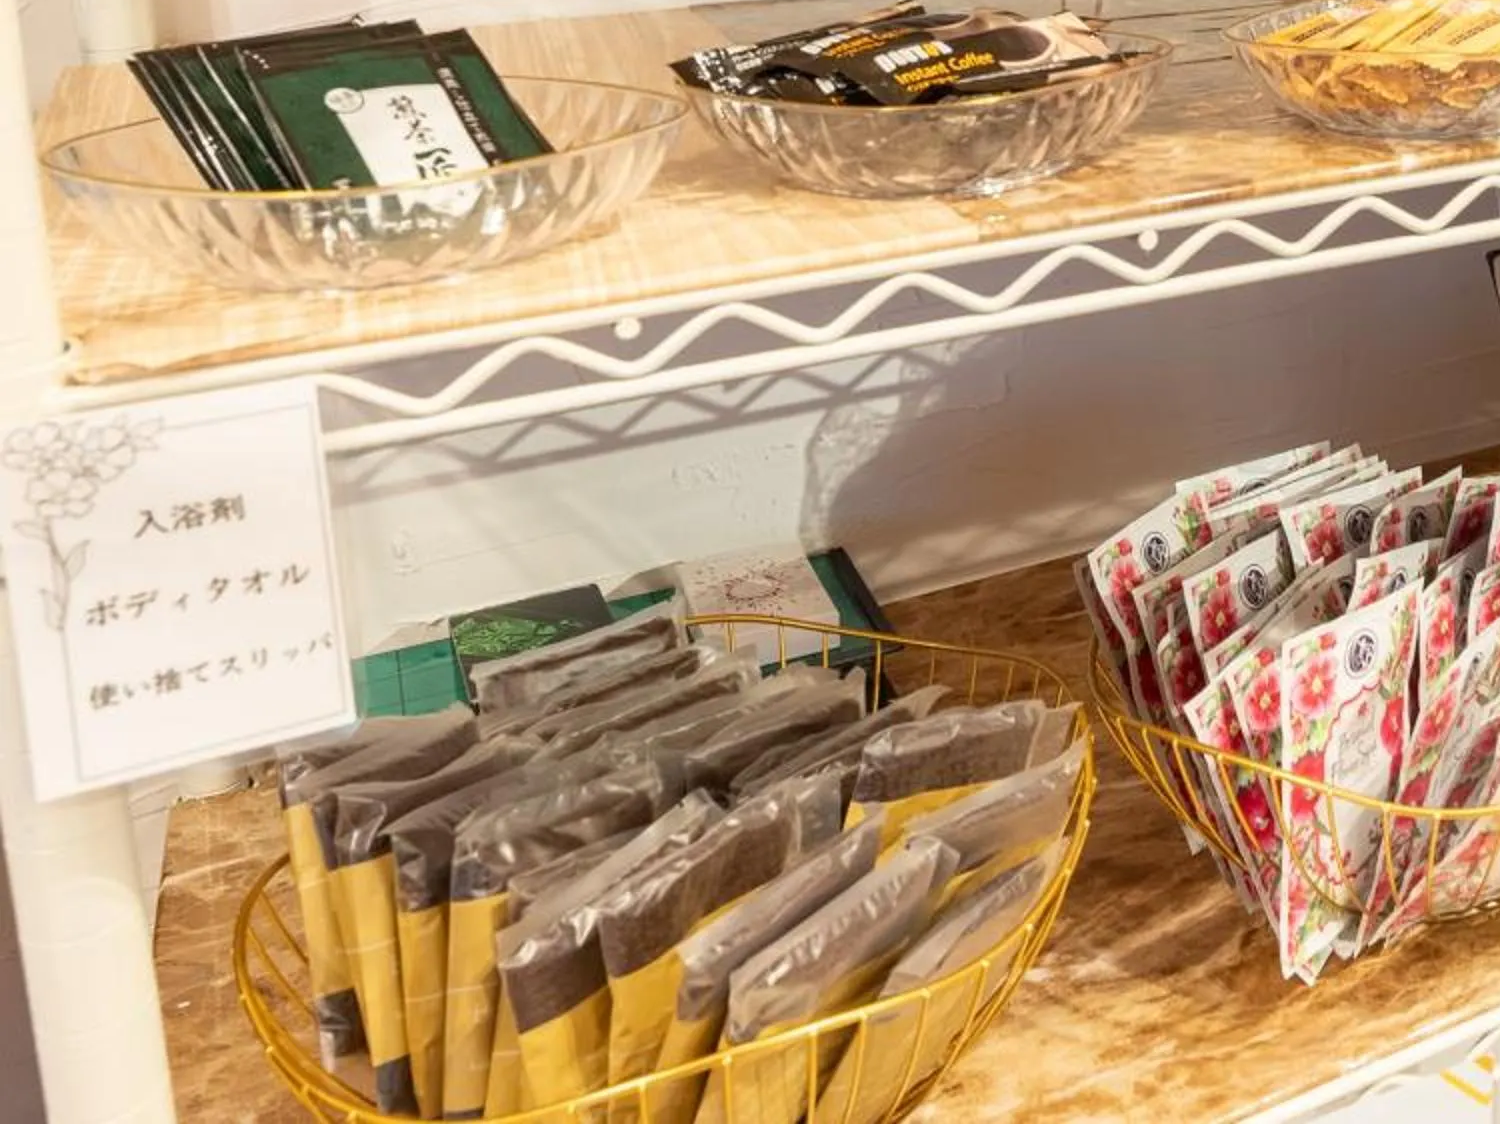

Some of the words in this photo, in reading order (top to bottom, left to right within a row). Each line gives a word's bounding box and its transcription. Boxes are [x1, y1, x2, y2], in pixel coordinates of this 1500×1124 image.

[894, 61, 949, 86] Instant
[949, 51, 995, 73] Coffee
[134, 493, 247, 540] 入浴剤
[86, 563, 311, 628] ボディタオル
[89, 631, 333, 712] 使い捨てスリッパ
